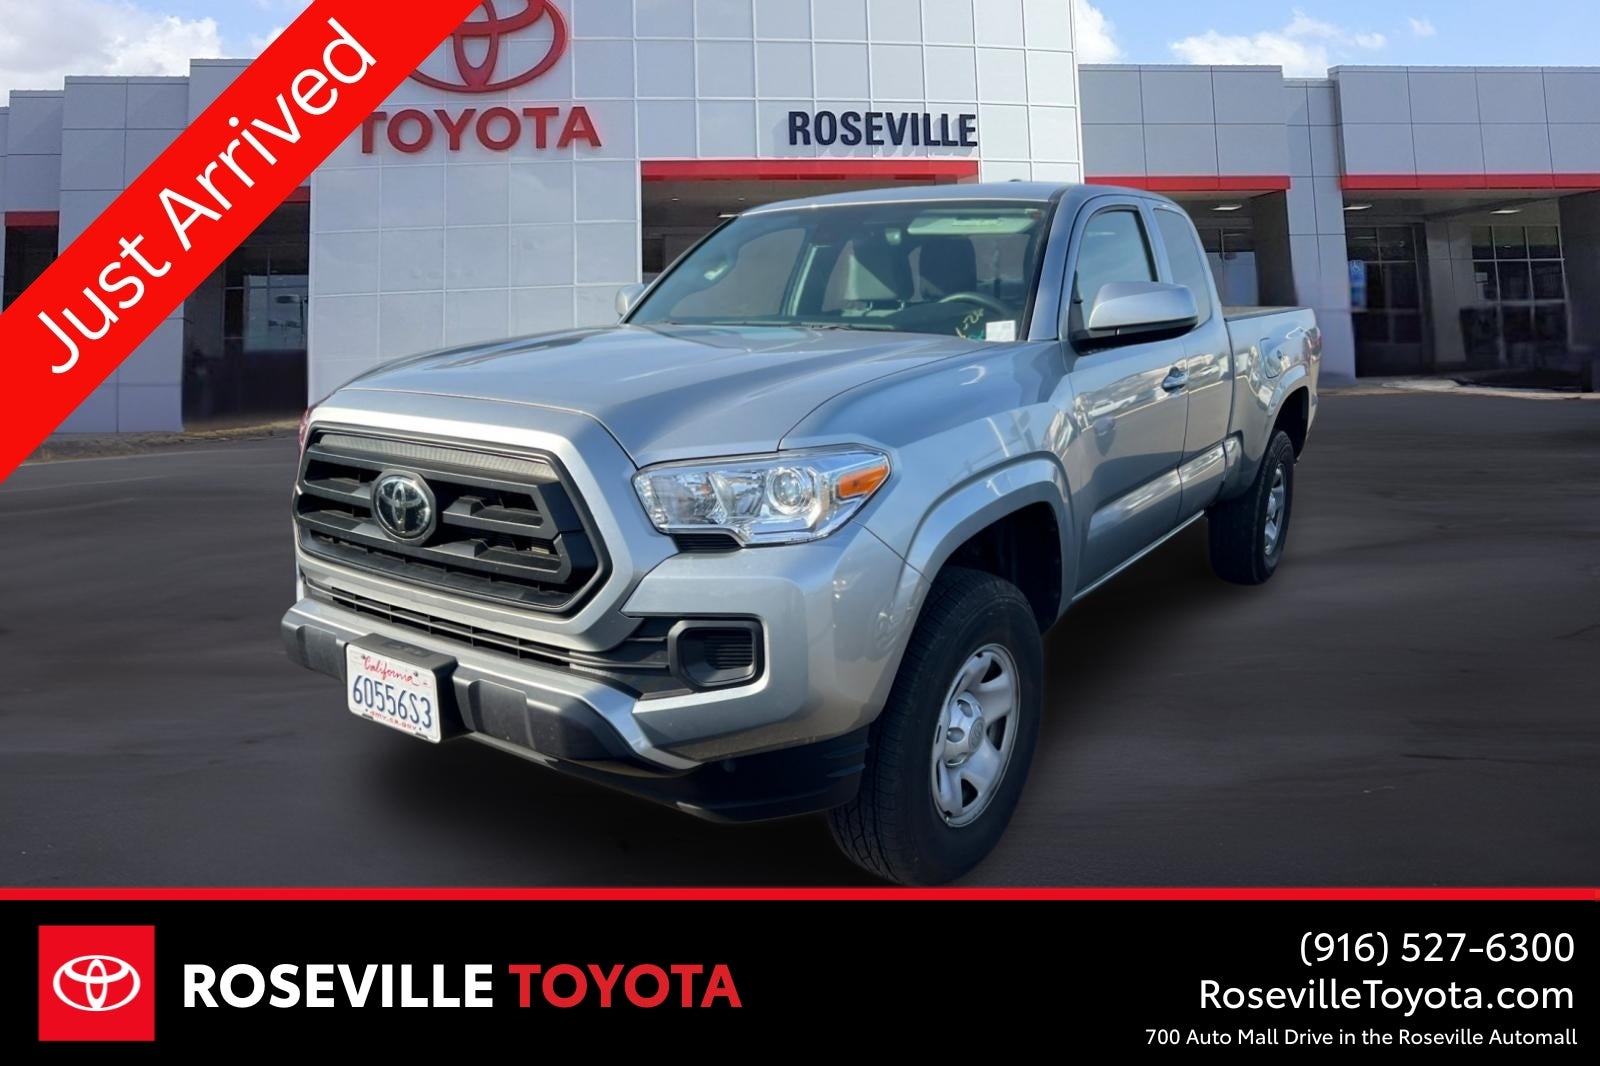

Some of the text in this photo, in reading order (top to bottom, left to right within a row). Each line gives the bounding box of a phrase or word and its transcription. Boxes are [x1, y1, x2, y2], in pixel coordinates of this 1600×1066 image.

[360, 106, 602, 154] TOYOTA
[788, 110, 978, 147] ROSEVILLE
[364, 655, 414, 682] California
[353, 675, 432, 729] 60556S3
